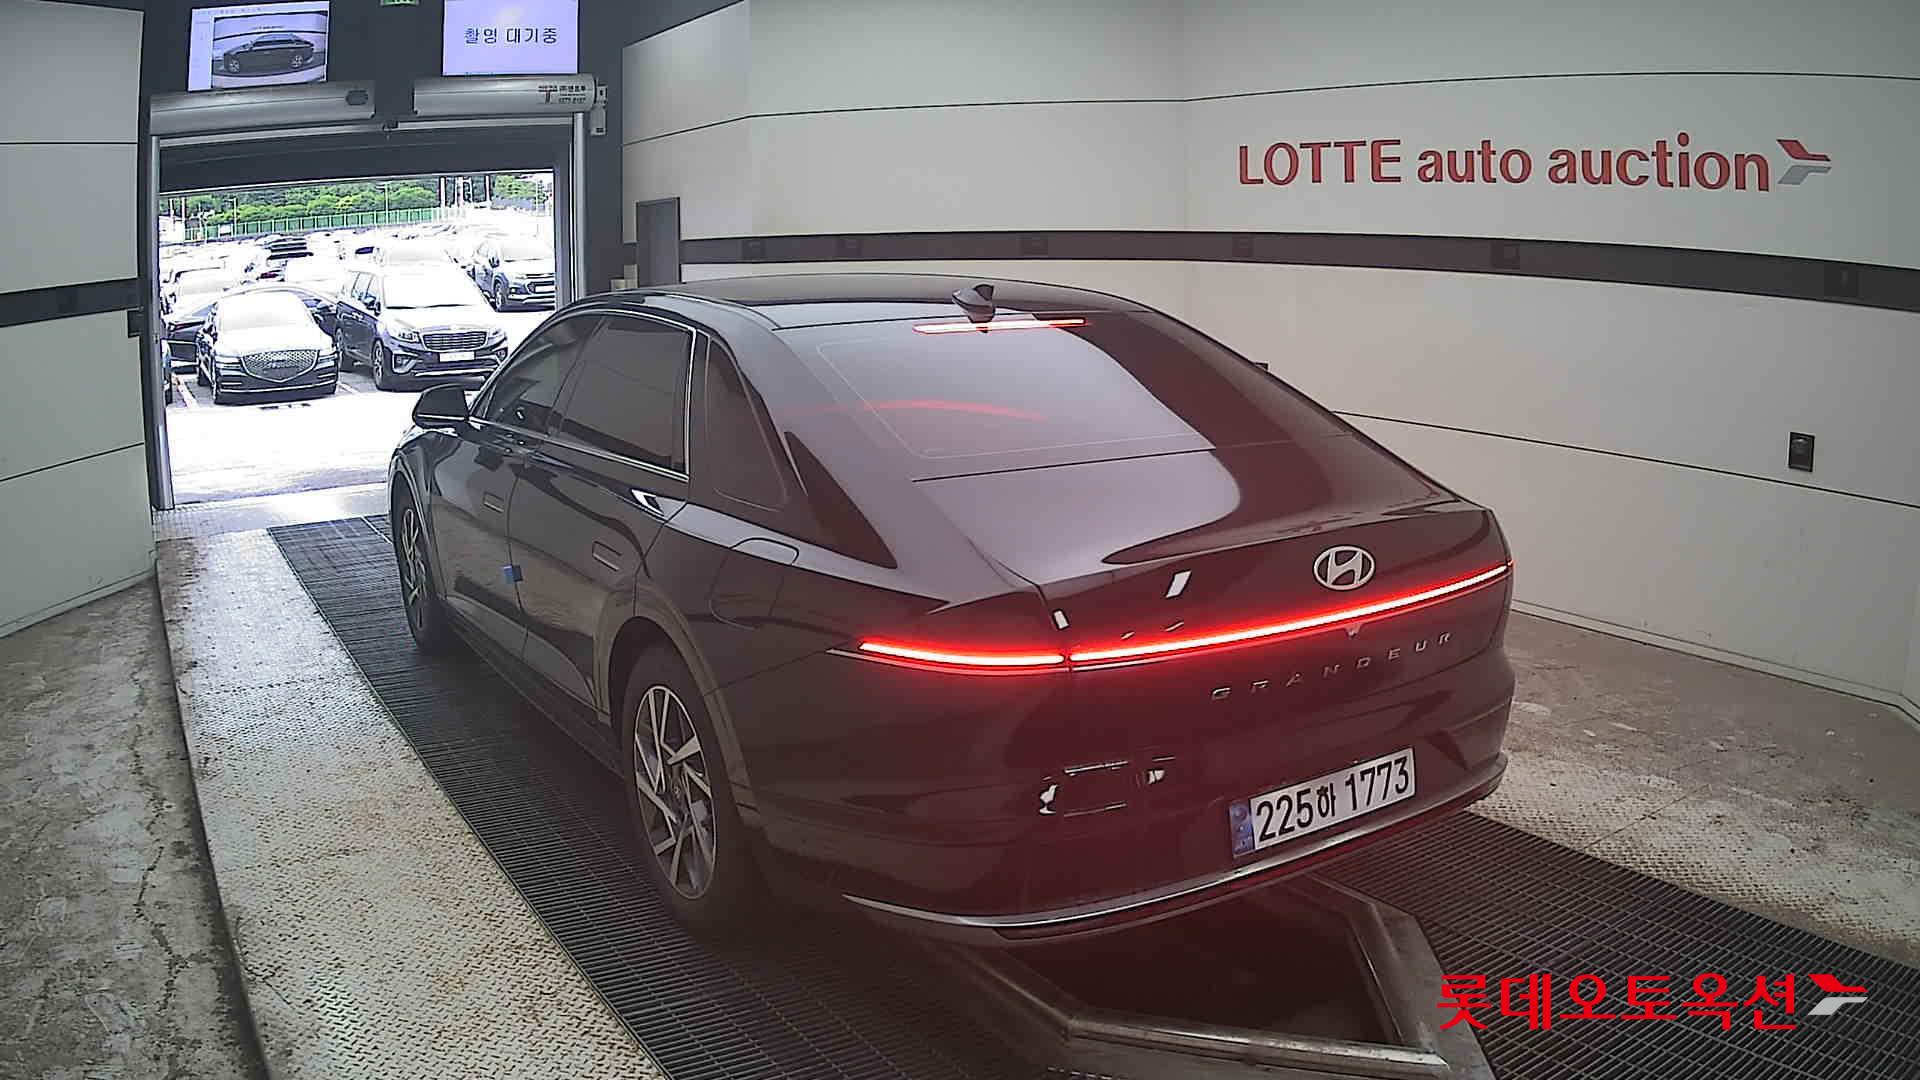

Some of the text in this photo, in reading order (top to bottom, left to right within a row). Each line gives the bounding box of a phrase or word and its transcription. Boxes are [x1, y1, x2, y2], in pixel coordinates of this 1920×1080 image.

[464, 27, 558, 45] 촬영 대기중
[1239, 131, 1770, 192] LOTTE auto auction
[1211, 632, 1451, 699] GRANDEUR
[1256, 756, 1409, 842] 225하 1773
